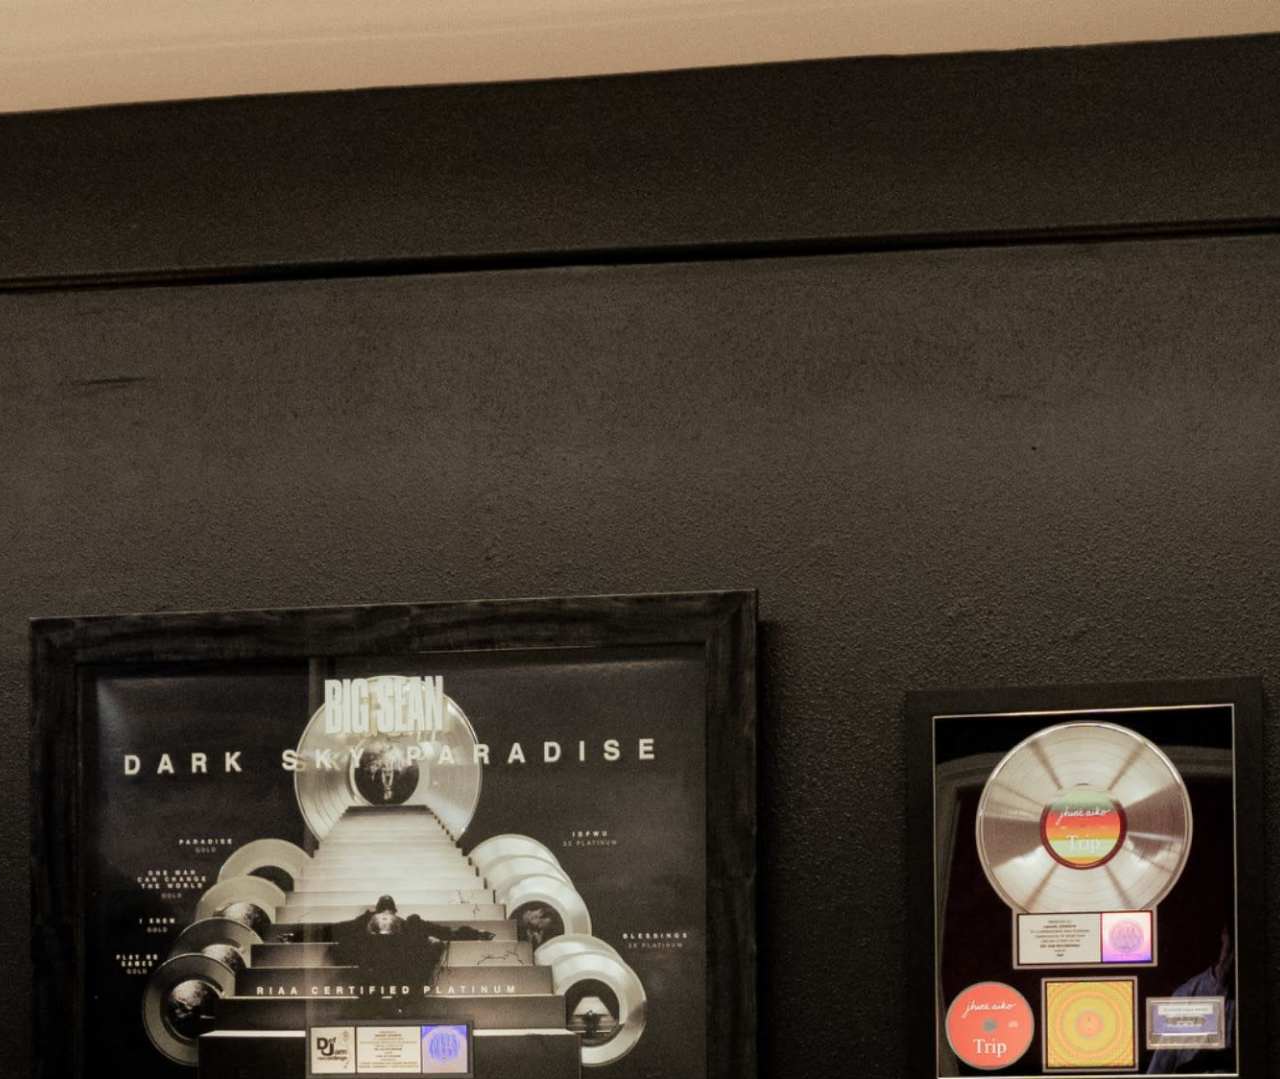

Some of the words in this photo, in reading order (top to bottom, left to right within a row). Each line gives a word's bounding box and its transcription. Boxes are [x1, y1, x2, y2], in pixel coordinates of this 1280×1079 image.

[324, 678, 369, 735] BIG
[376, 675, 444, 733] SEAN
[124, 752, 242, 775] DARK
[281, 749, 365, 771] SKY
[407, 738, 655, 766] PARADISE
[256, 985, 299, 995] RIAA
[311, 984, 411, 995] CERTIFIED
[423, 984, 517, 995] PLATINUM
[972, 1038, 1008, 1059] Trip
